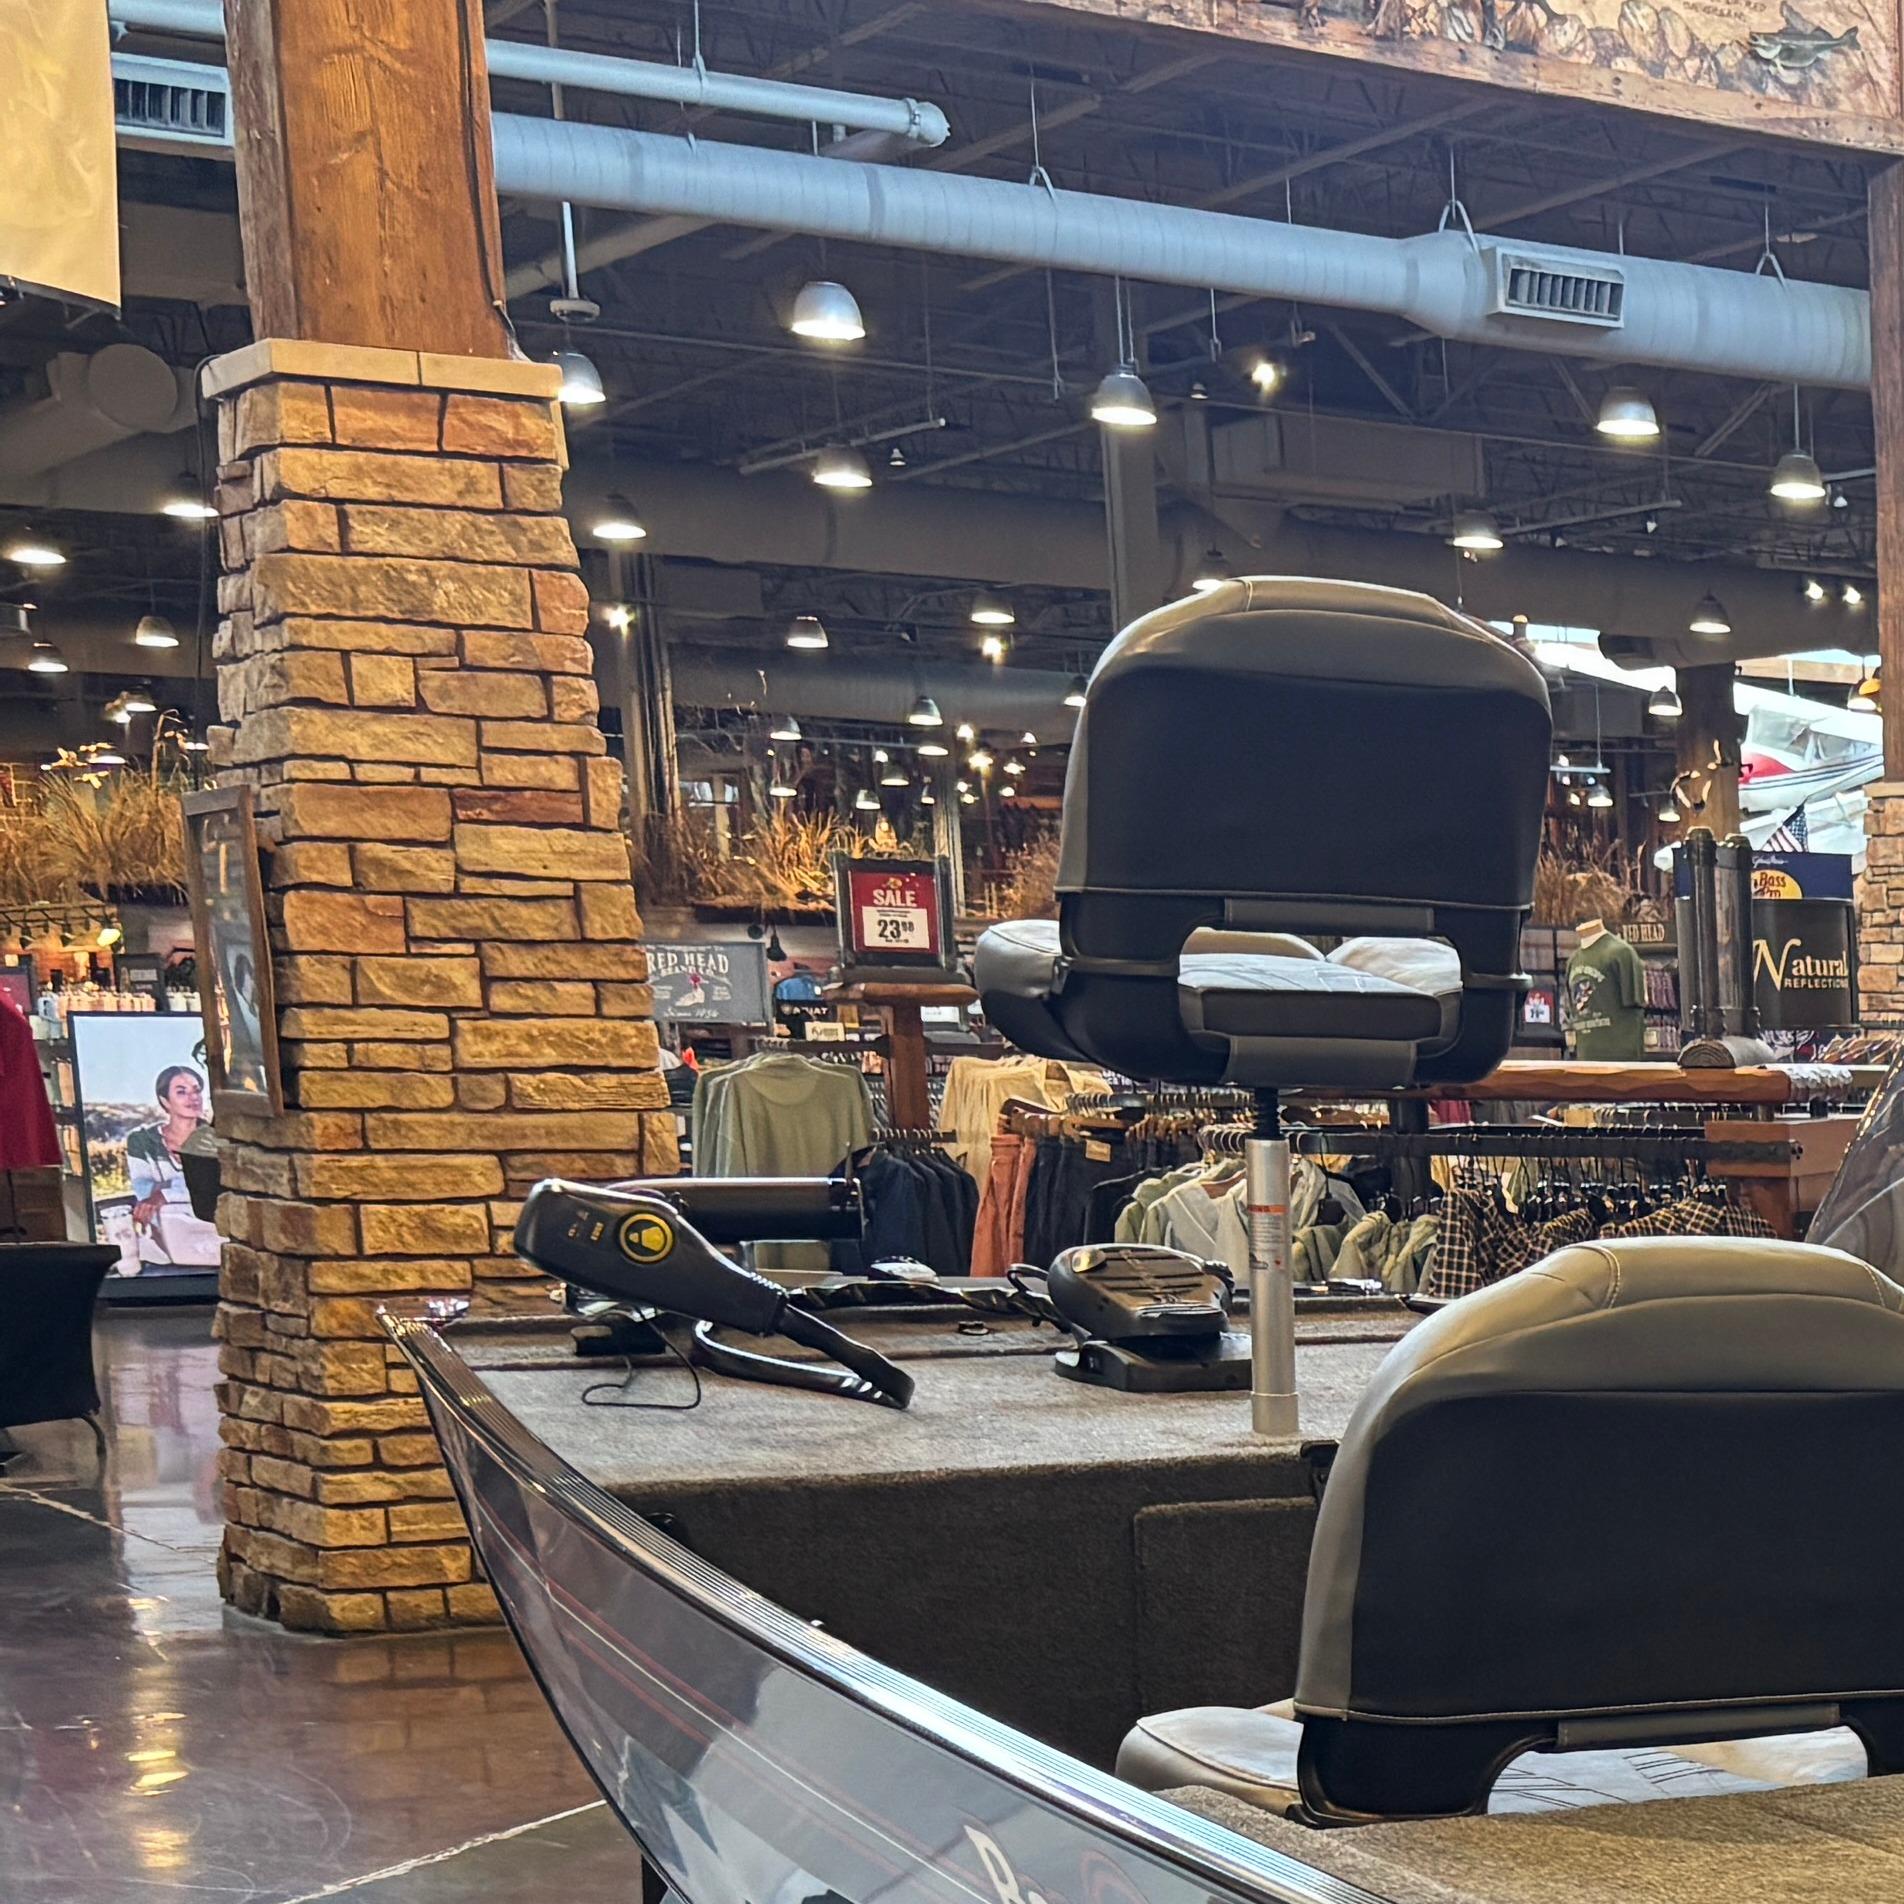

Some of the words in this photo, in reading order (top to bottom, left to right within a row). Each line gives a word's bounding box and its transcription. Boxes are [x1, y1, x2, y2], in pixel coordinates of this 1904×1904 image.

[1760, 871, 1787, 888] Bass
[872, 888, 918, 908] SALE
[684, 951, 729, 974] HEAD
[1752, 938, 1849, 992] Natural
